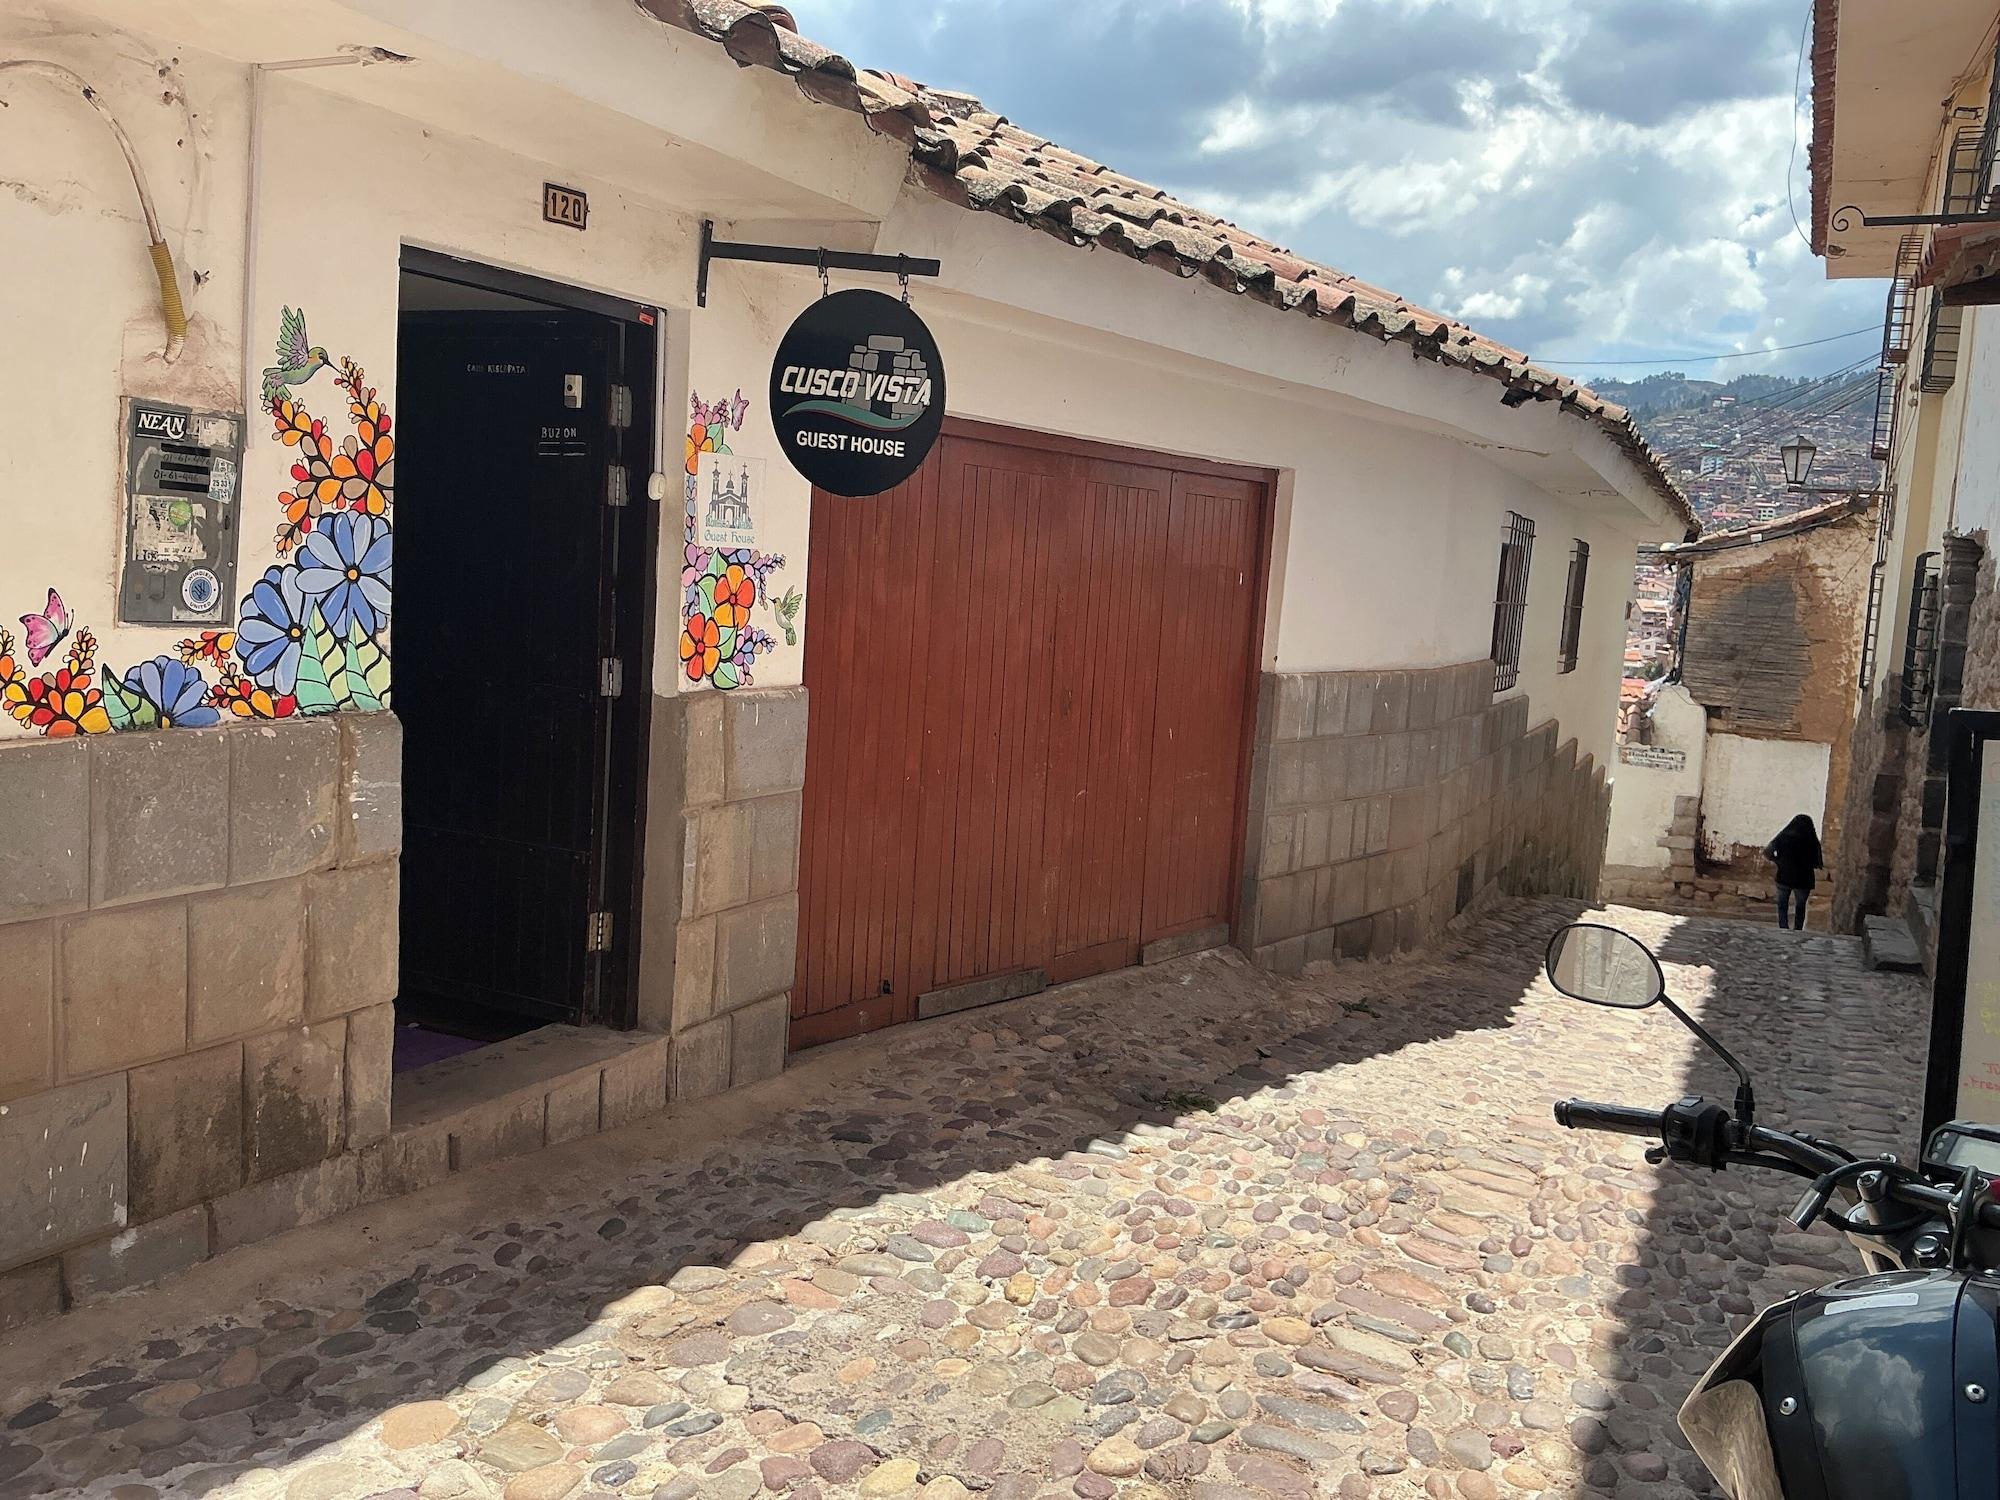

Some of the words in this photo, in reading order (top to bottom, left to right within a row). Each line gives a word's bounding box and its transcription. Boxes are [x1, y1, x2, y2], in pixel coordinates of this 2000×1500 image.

[551, 192, 581, 222] 120
[780, 366, 860, 399] CUSCO
[864, 373, 932, 407] VISTA
[138, 412, 185, 439] NEAN
[796, 430, 849, 450] GUEST
[851, 437, 906, 458] HOUSE
[189, 601, 212, 610] UNITED
